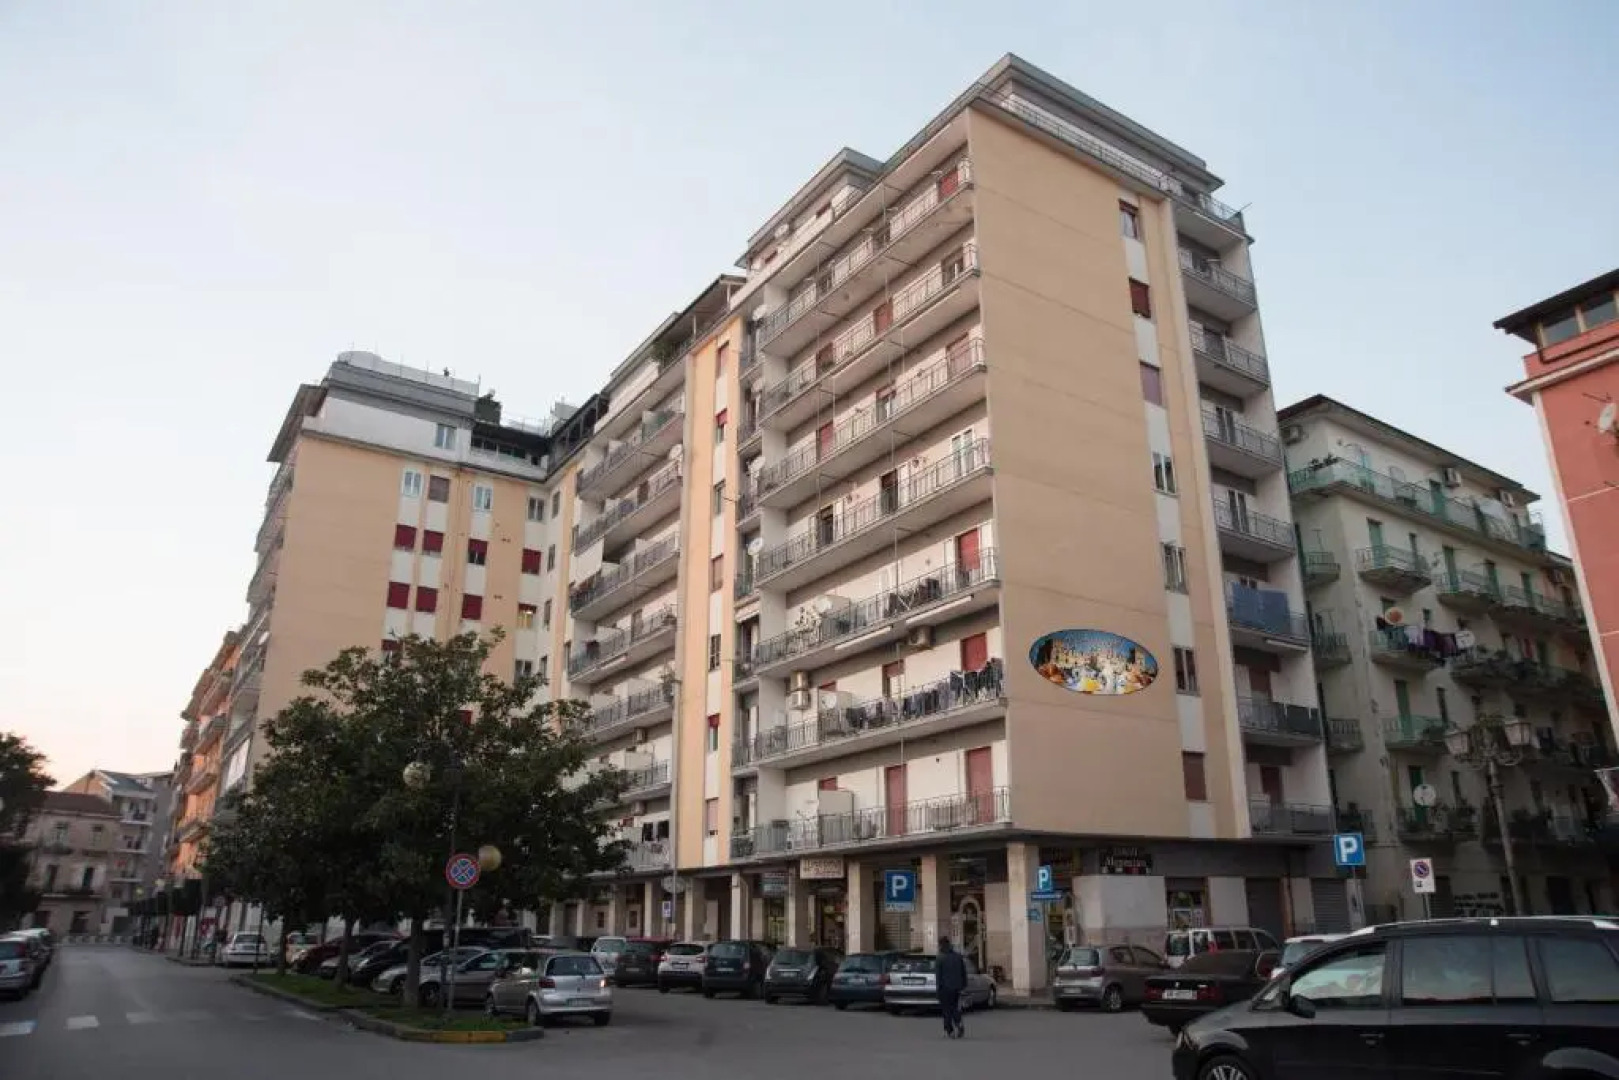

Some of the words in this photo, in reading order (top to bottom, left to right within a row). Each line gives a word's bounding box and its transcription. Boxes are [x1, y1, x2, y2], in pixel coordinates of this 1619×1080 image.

[1339, 837, 1358, 863] P
[892, 875, 907, 897] P
[1039, 869, 1049, 889] P
